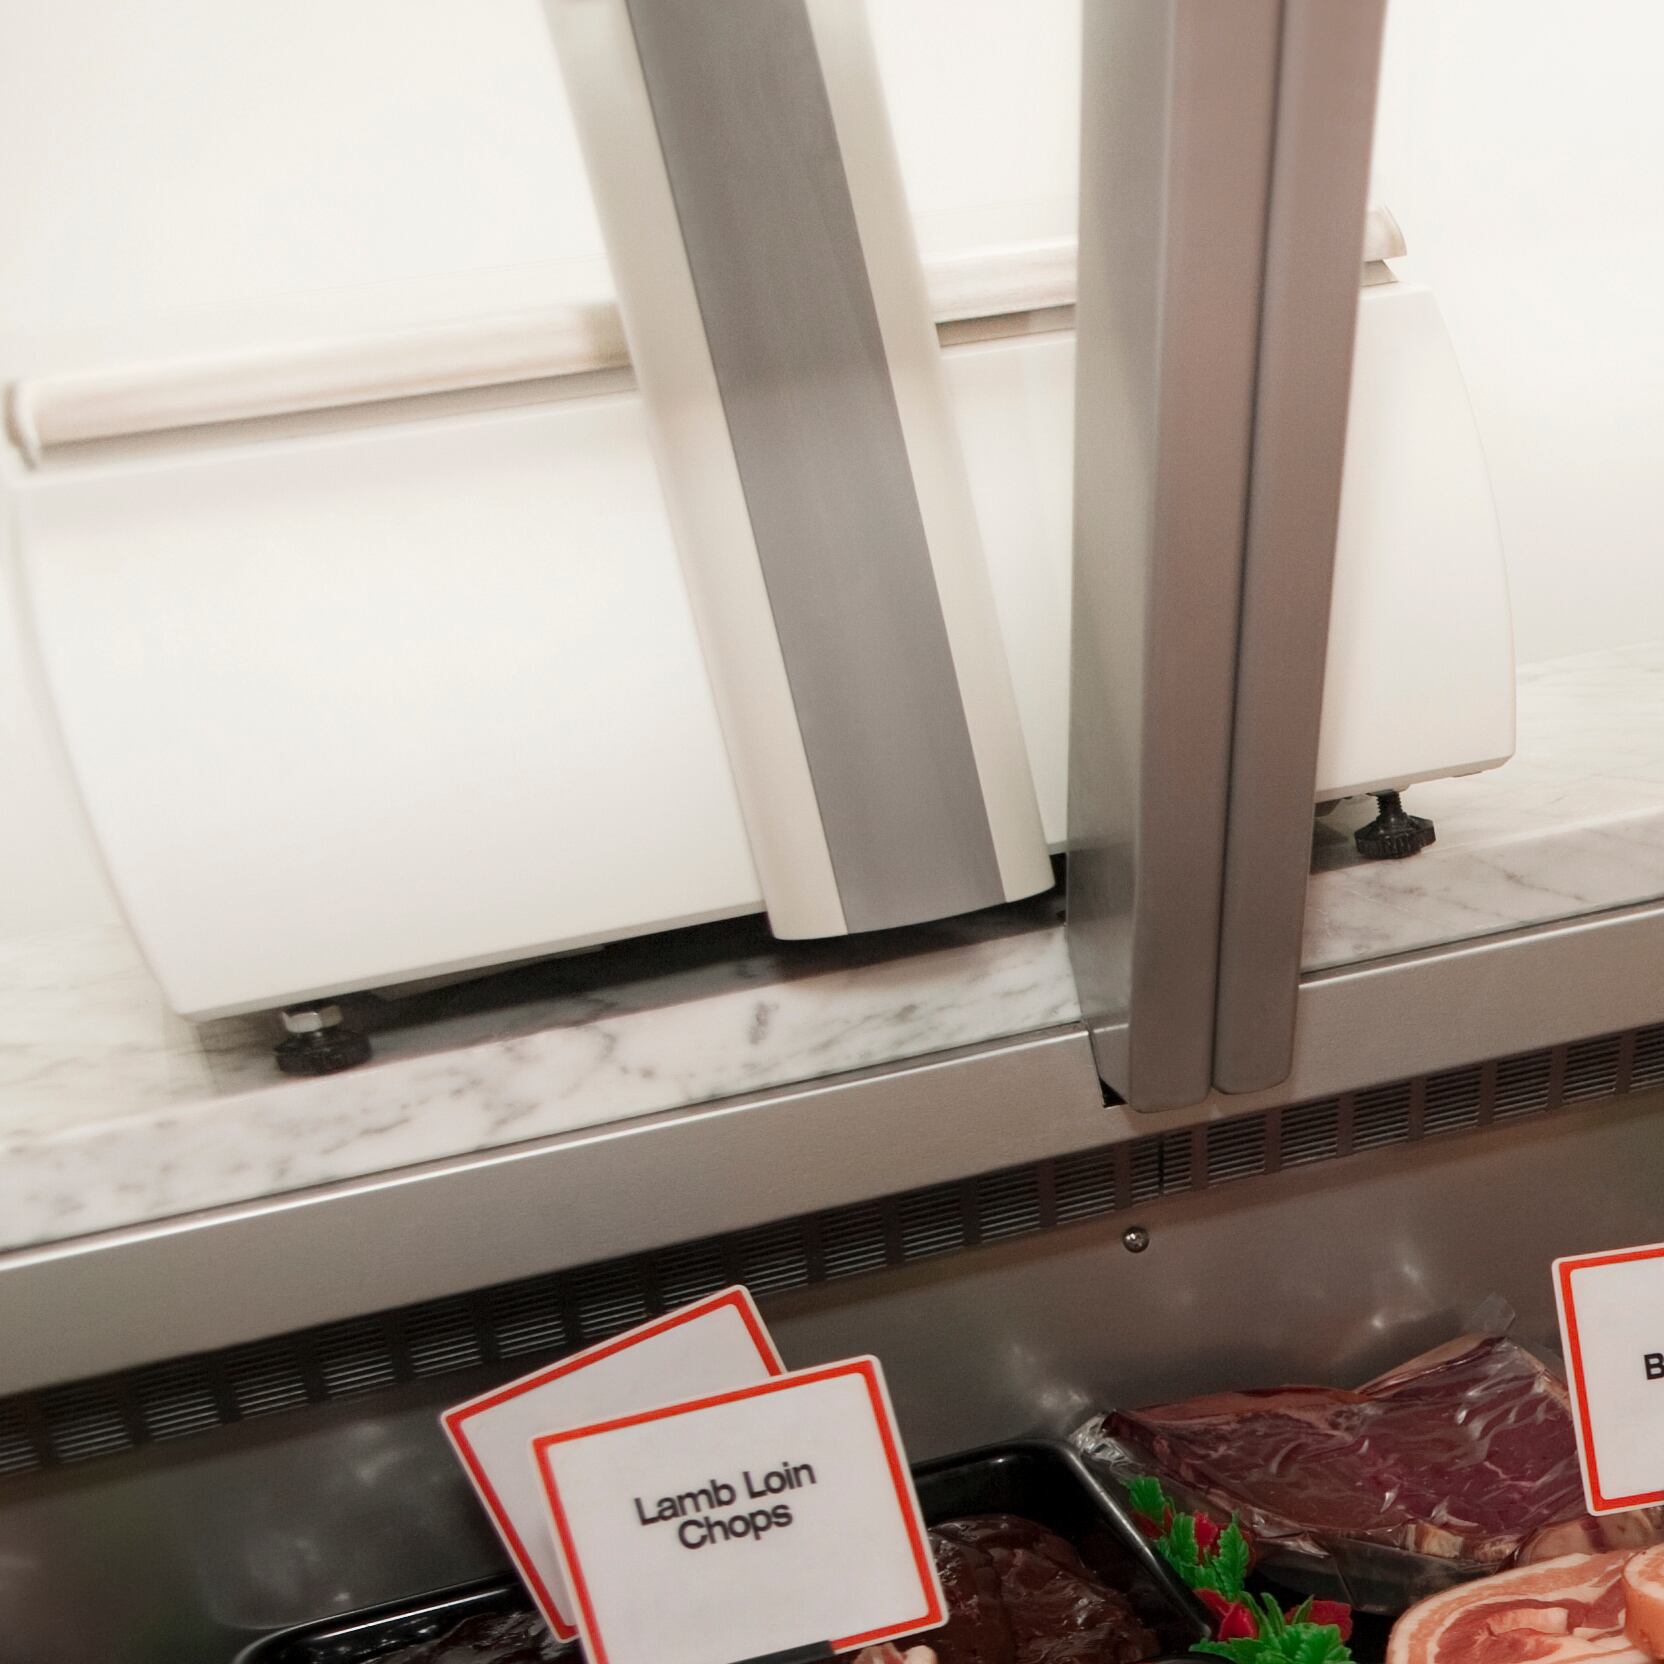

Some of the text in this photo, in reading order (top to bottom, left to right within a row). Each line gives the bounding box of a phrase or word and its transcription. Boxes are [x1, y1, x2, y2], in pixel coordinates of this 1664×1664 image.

[633, 1461, 817, 1527] Lamb Loin
[677, 1503, 793, 1550] Chops
